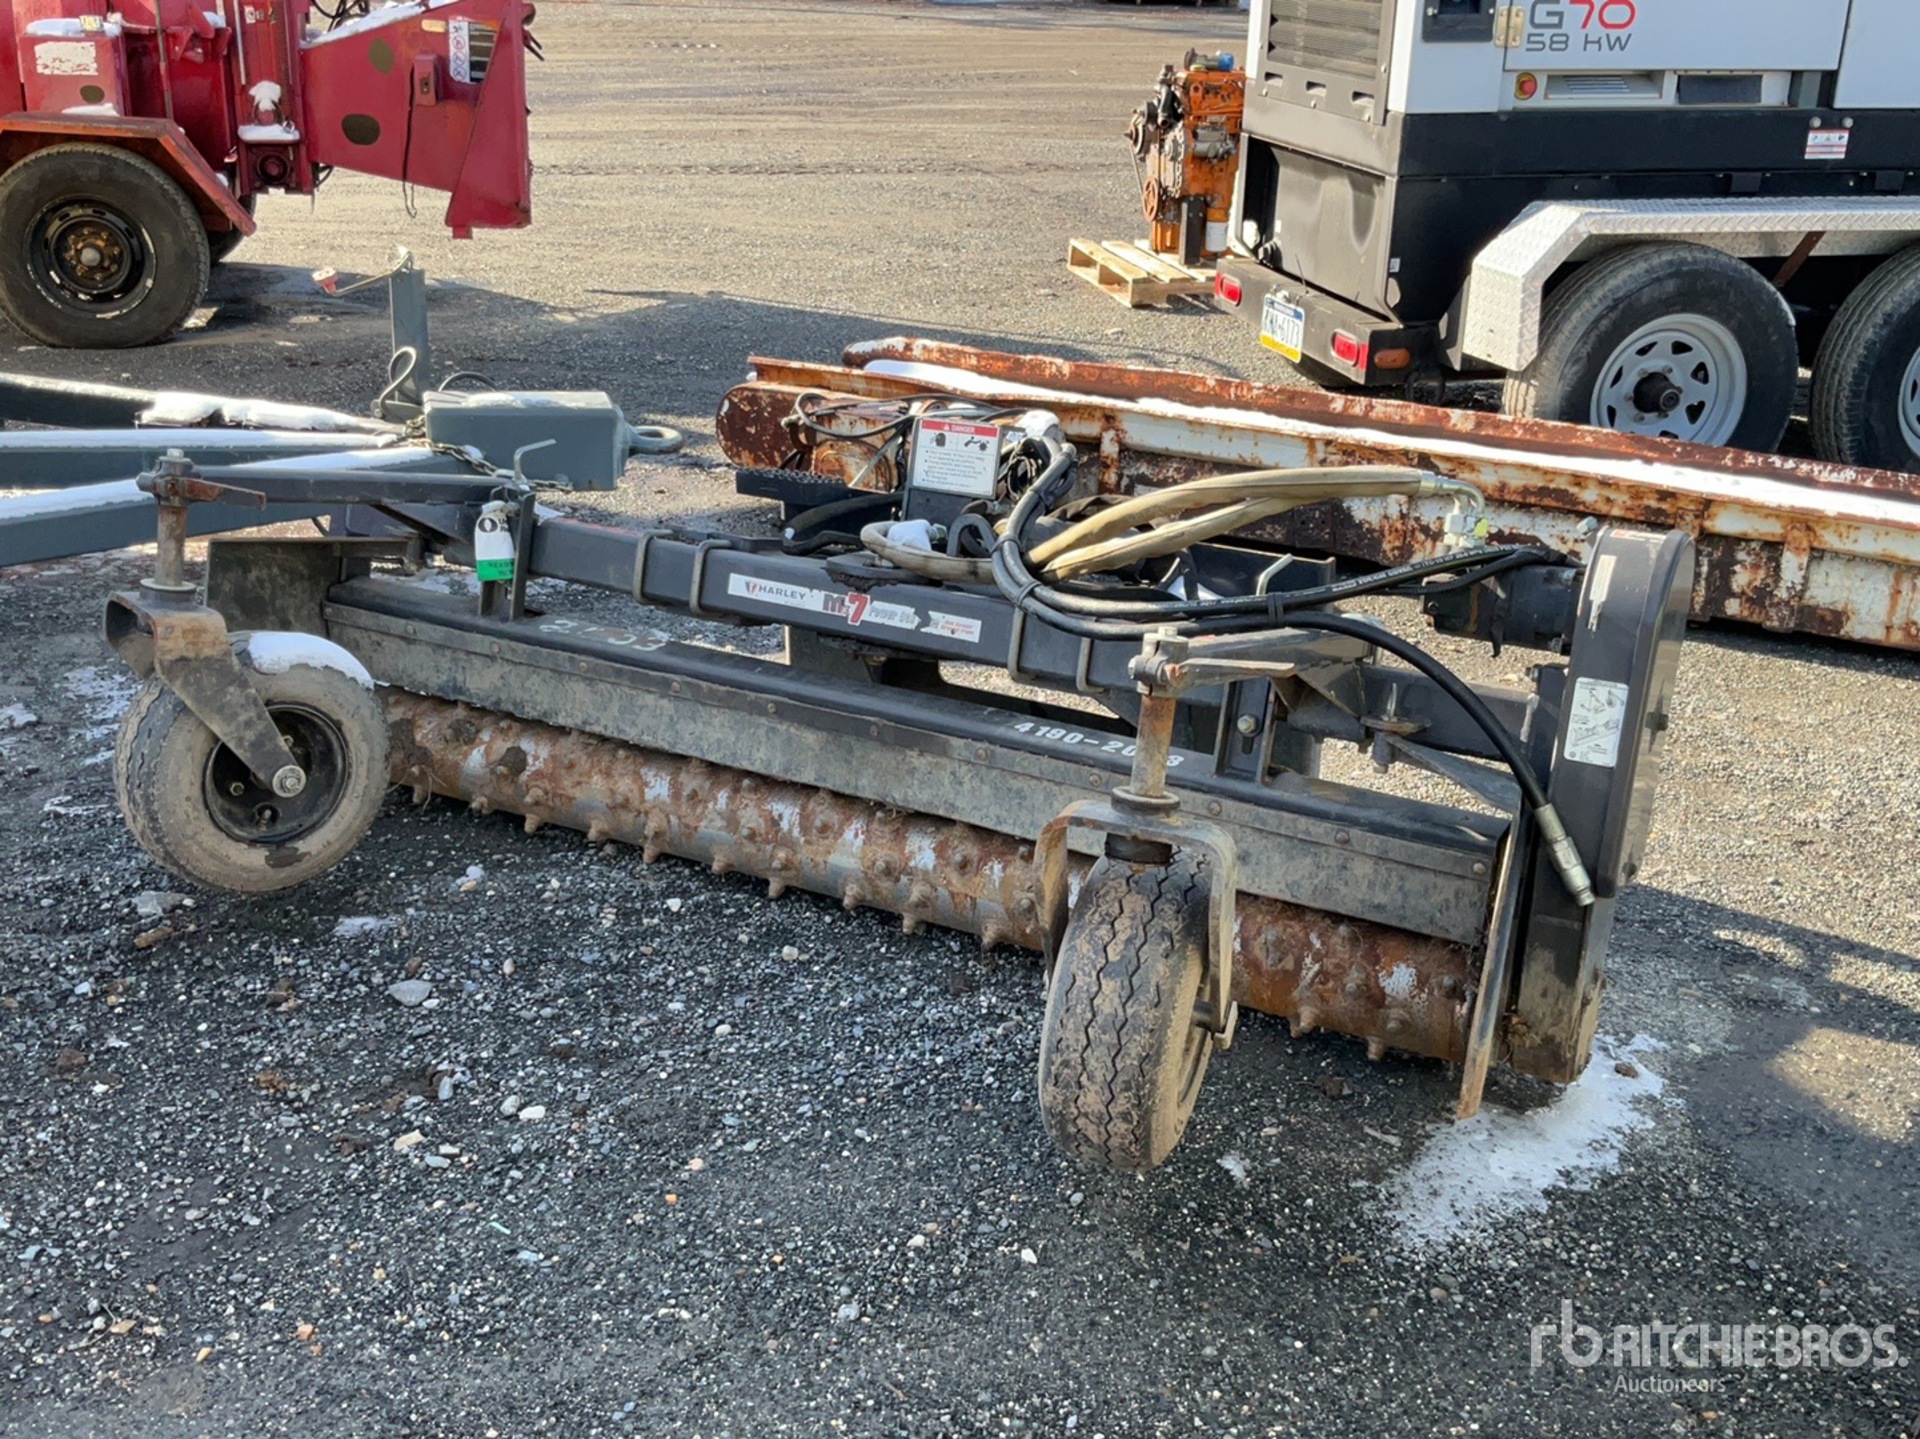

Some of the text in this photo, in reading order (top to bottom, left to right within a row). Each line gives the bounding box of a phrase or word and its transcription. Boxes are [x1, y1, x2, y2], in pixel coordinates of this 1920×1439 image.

[1529, 0, 1637, 30] G70
[1525, 33, 1570, 52] 58
[950, 424, 976, 433] DANGER
[758, 584, 807, 600] HARLEY
